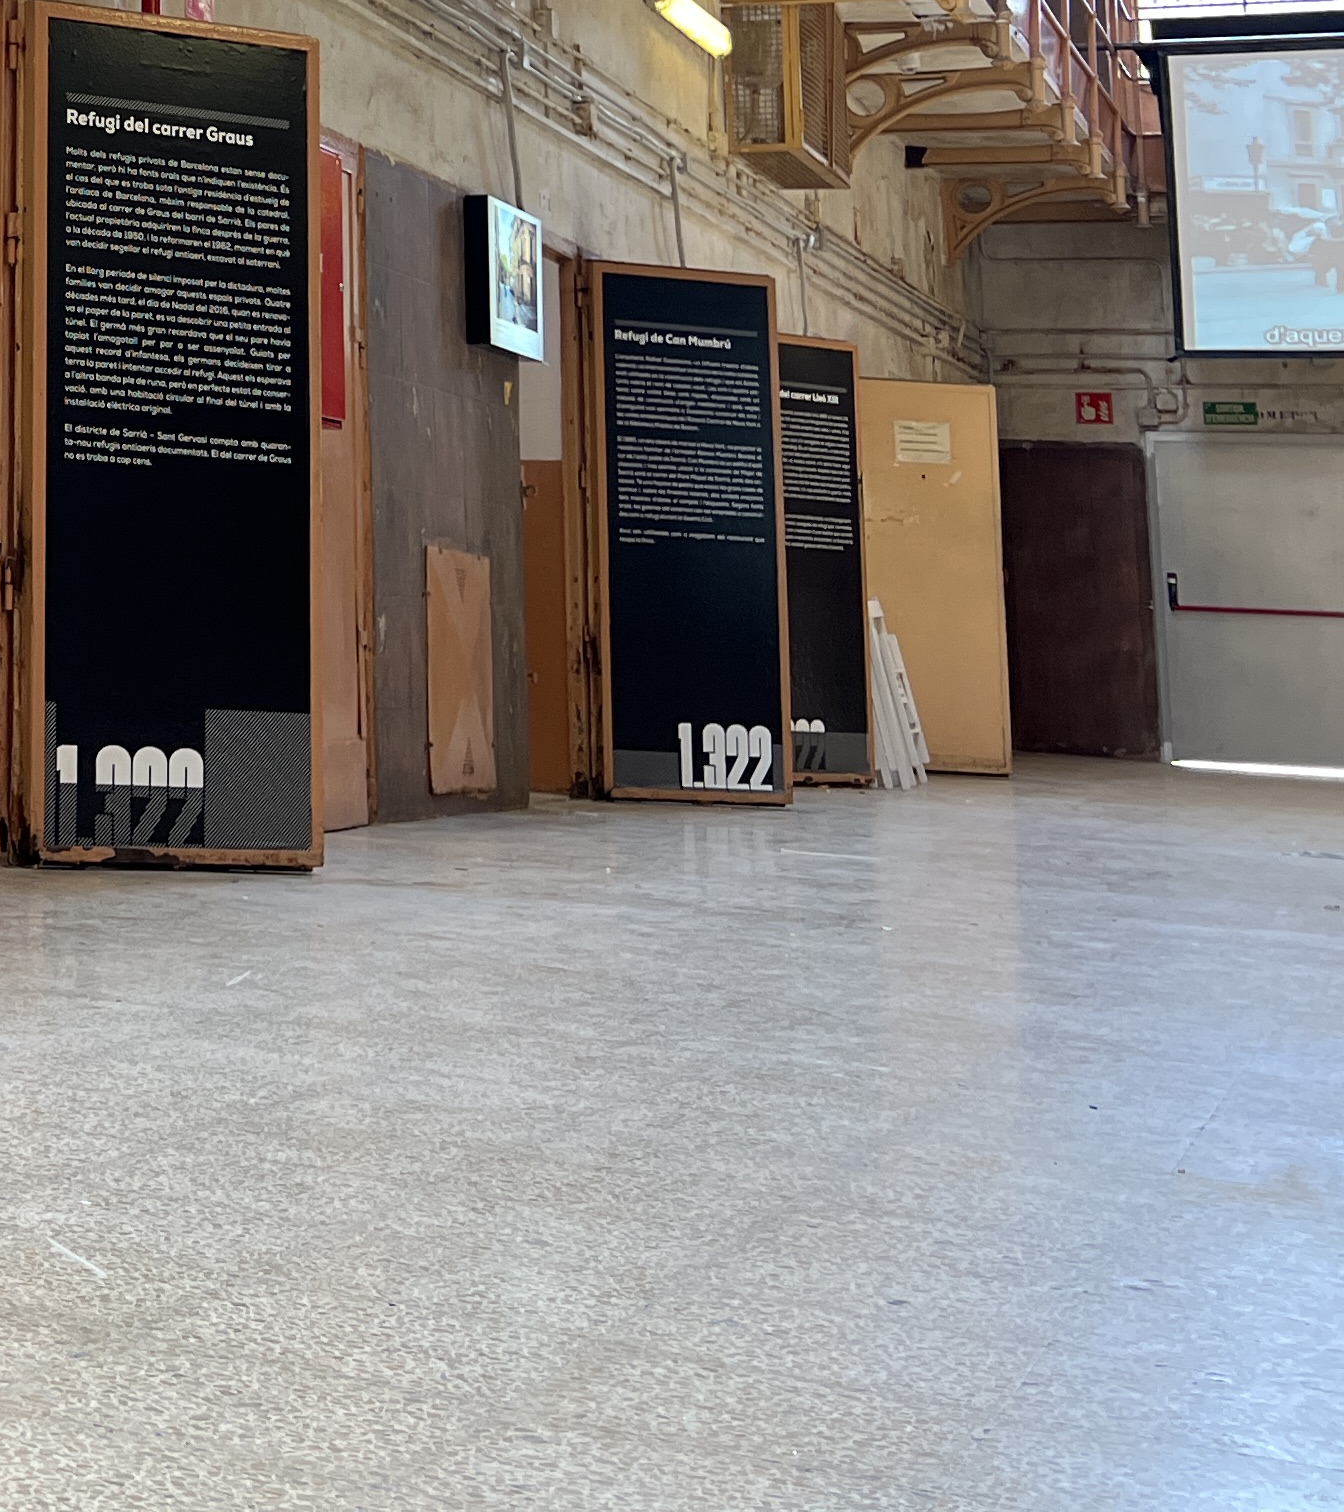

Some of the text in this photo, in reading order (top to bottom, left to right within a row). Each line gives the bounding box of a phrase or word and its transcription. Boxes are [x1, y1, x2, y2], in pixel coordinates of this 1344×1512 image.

[66, 108, 253, 146] Refugi del carrer Graus
[614, 329, 648, 344] Refugi
[650, 332, 663, 343] de
[665, 333, 686, 345] Can
[1266, 327, 1344, 347] d'aque
[678, 722, 774, 792] 1.322
